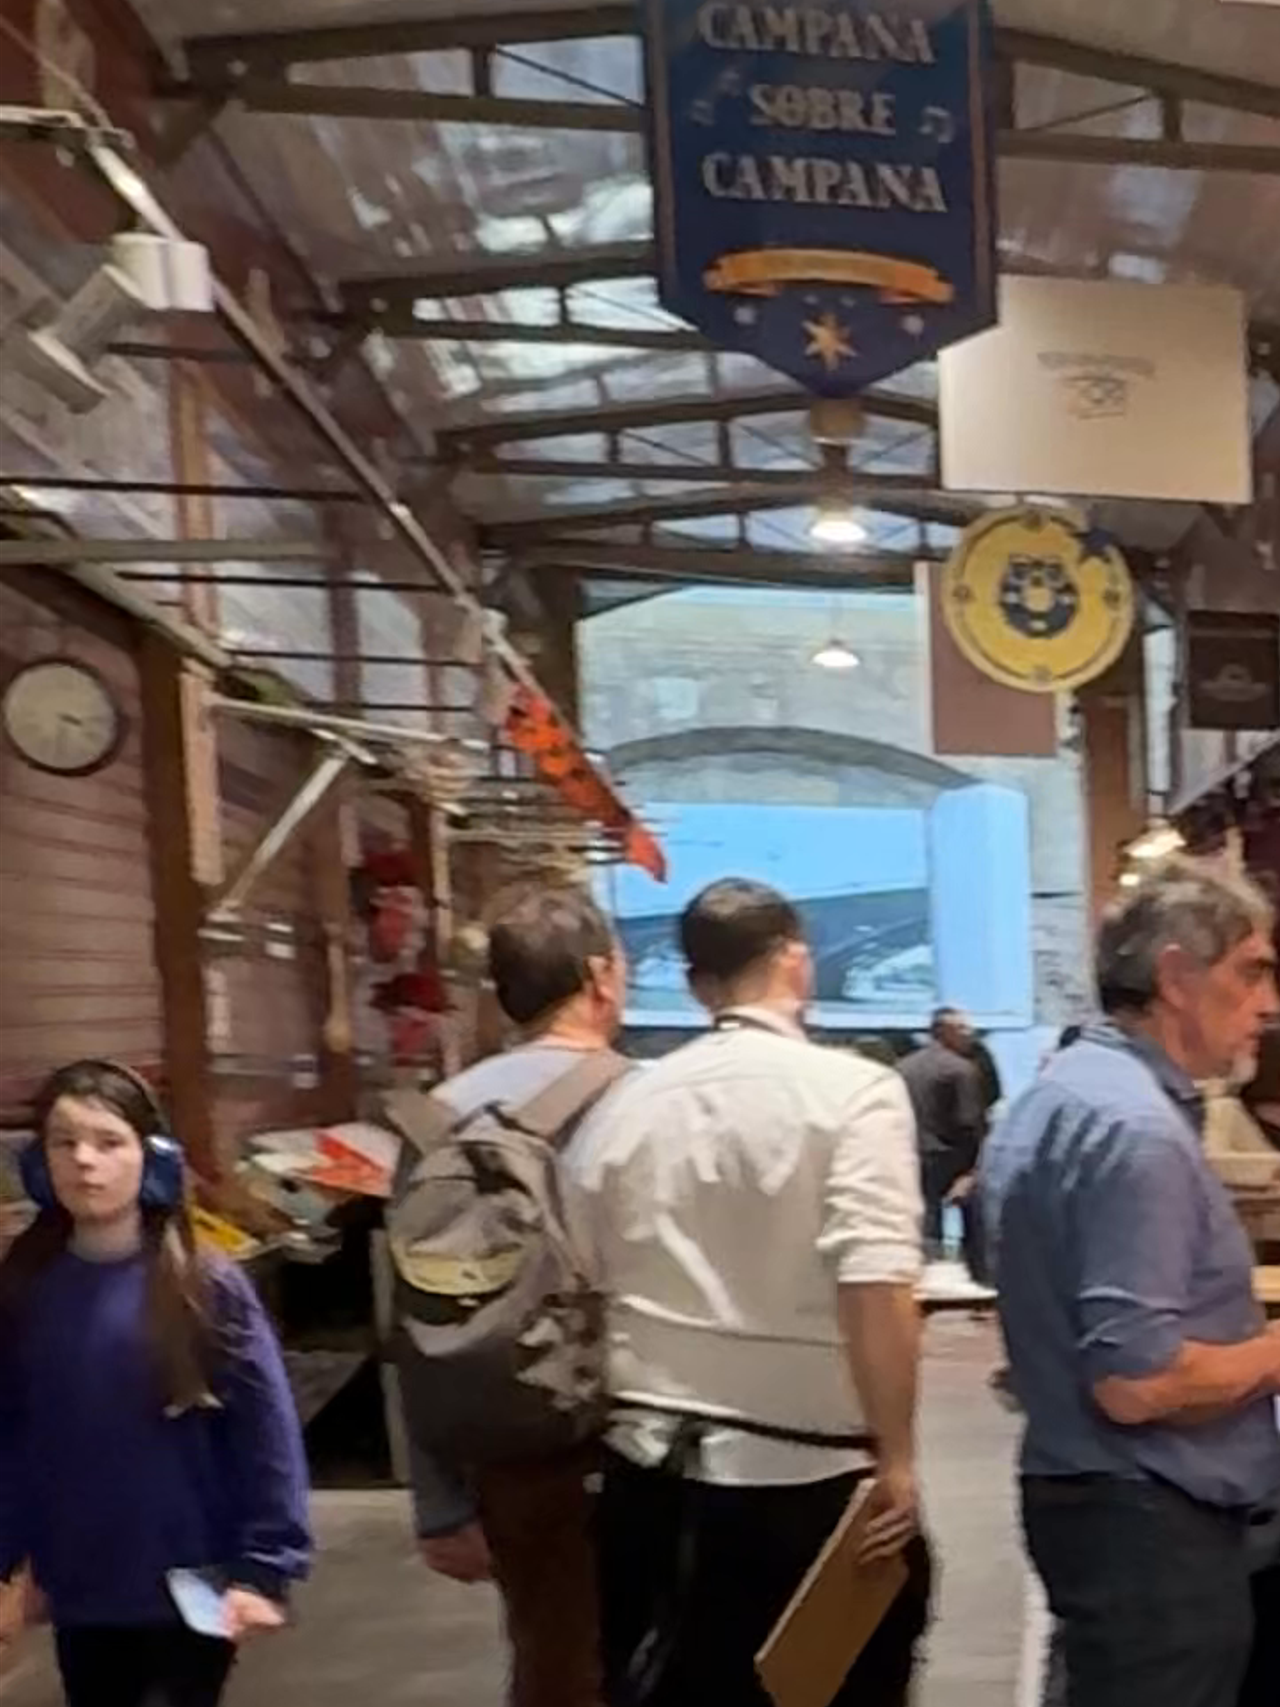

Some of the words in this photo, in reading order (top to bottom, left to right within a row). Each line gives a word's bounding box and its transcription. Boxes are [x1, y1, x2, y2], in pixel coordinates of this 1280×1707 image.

[699, 2, 937, 64] CAMPANA
[750, 82, 897, 137] SOBRE
[702, 151, 948, 213] CAMPANA
